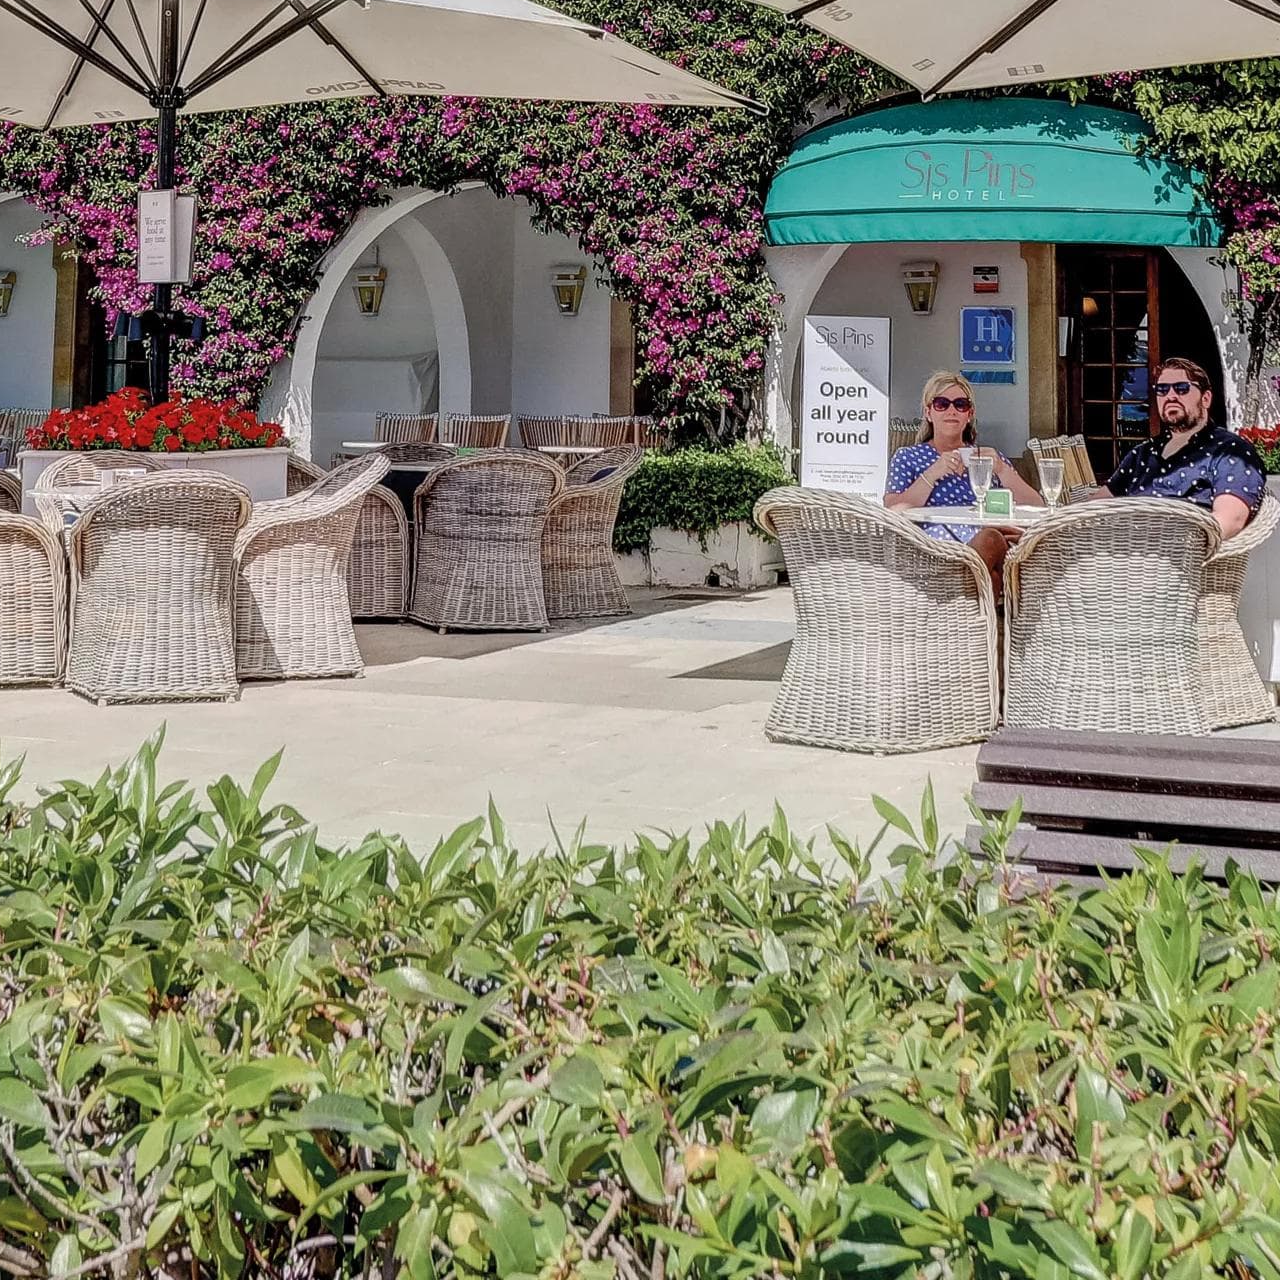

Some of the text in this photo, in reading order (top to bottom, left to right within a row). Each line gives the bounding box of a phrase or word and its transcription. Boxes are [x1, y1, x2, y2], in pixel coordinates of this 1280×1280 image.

[900, 148, 1036, 196] Sis Pins
[932, 189, 1006, 201] HOTEL
[815, 325, 874, 349] Sis Pins
[974, 315, 1001, 342] H
[820, 381, 868, 401] Open
[811, 405, 877, 424] all year
[817, 429, 870, 445] round
